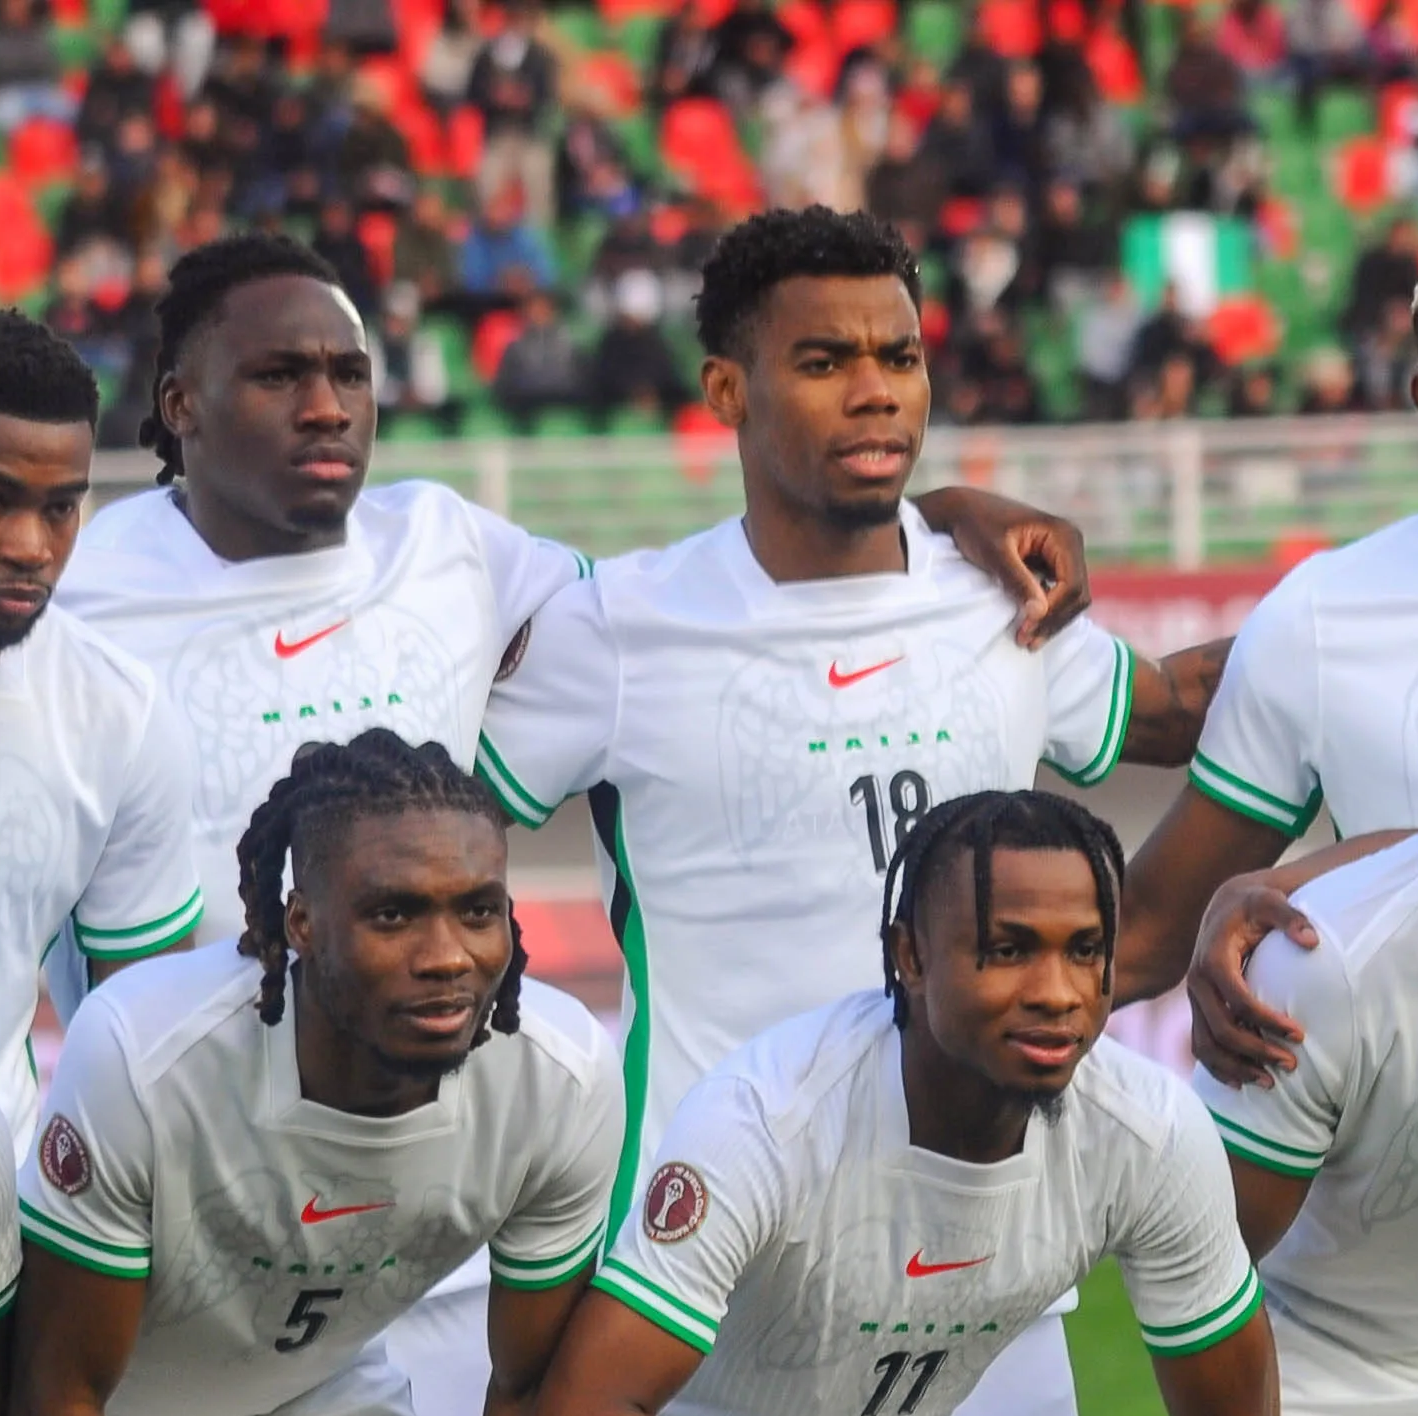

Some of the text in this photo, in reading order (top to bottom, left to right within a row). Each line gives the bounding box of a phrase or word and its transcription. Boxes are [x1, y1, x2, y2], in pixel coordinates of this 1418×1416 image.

[262, 693, 402, 724] NAIJA
[809, 729, 952, 752] NAIJA
[849, 769, 932, 877] 18
[275, 1288, 344, 1353] 5
[859, 1321, 998, 1335] NAIJA
